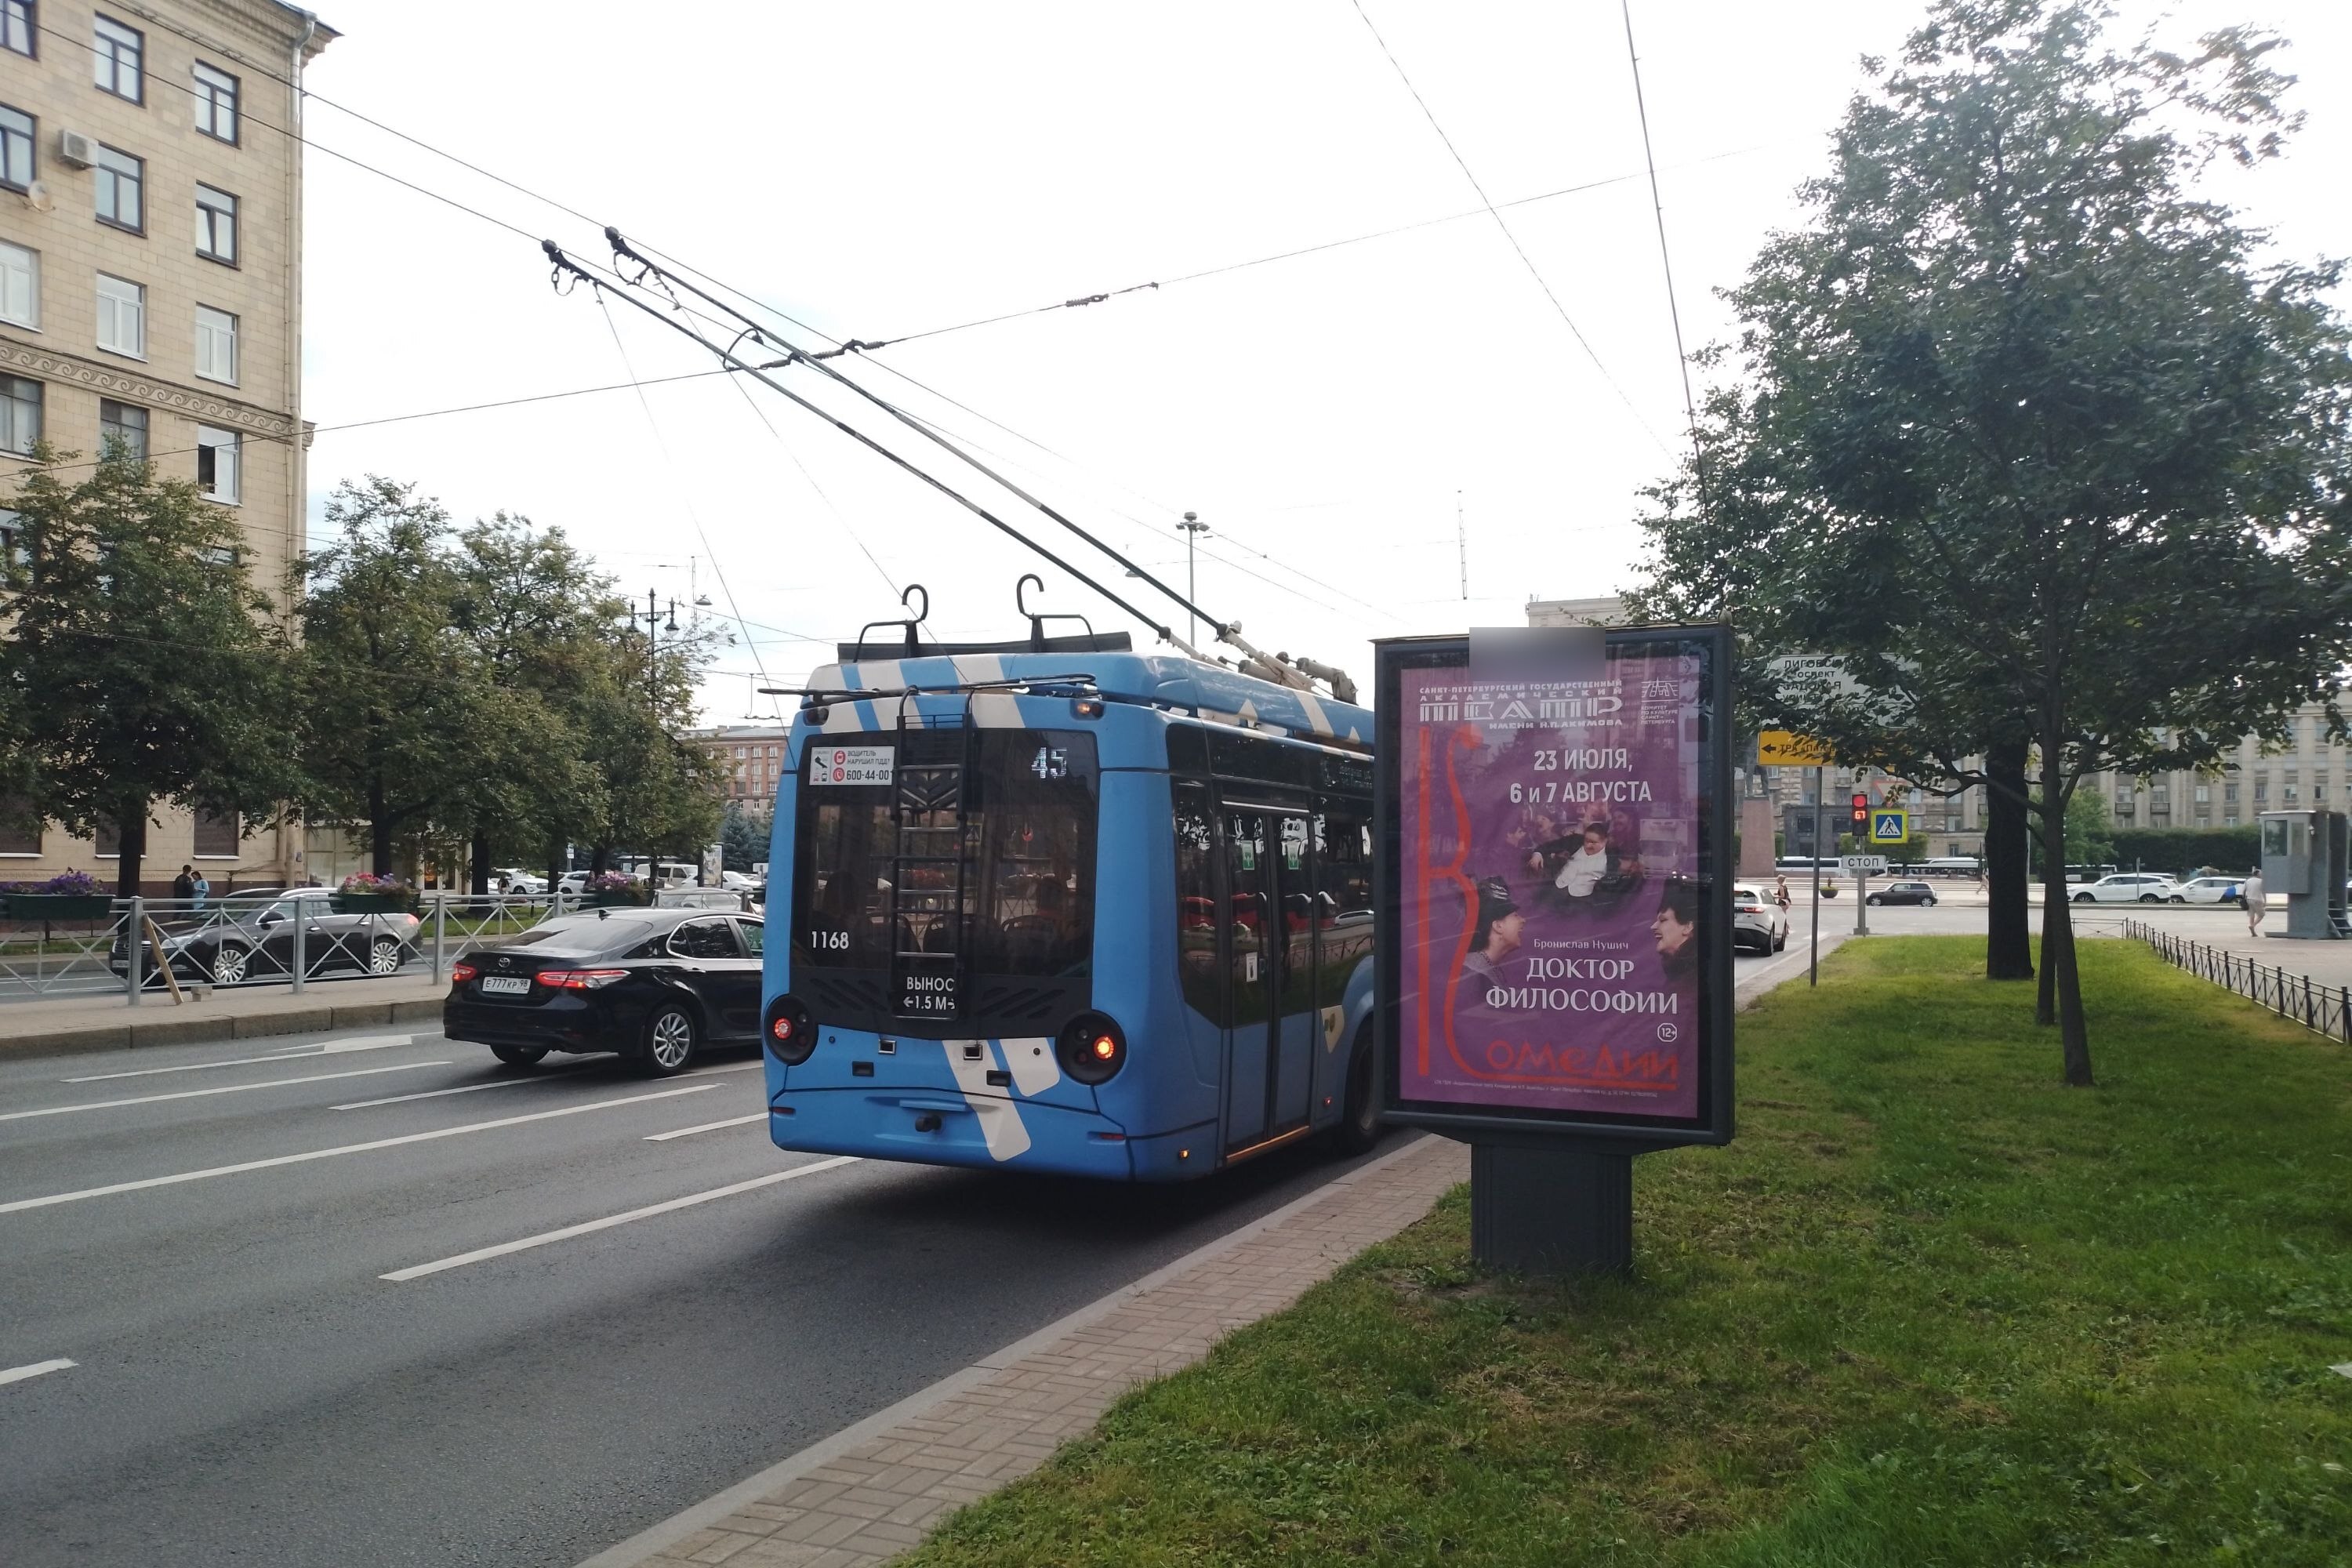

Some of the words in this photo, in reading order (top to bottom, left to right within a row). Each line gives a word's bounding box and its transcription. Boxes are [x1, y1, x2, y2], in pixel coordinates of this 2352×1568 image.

[1530, 679, 1622, 691] ГОСУДАРСТВЕННЫЙ
[1490, 721, 1534, 730] ИМЕНИ
[1031, 747, 1067, 779] 45
[1534, 750, 1557, 771] 23
[1564, 747, 1633, 772] ИЮЛЯ,
[846, 769, 889, 780] 600-44-00
[1509, 783, 1522, 804] 6
[1547, 782, 1557, 802] 7
[1563, 781, 1652, 803] АВГУСТА
[1848, 858, 1878, 867] СТОП
[811, 931, 849, 949] 1168
[1534, 938, 1589, 949] Бронислав
[1592, 939, 1629, 951] Нушич
[1526, 957, 1635, 982] ДОКТОР
[906, 976, 955, 992] ВЫНОС
[915, 995, 932, 1010] 1.5
[1486, 985, 1678, 1014] ФИЛОСОФИИ
[1661, 1027, 1676, 1038] 12+
